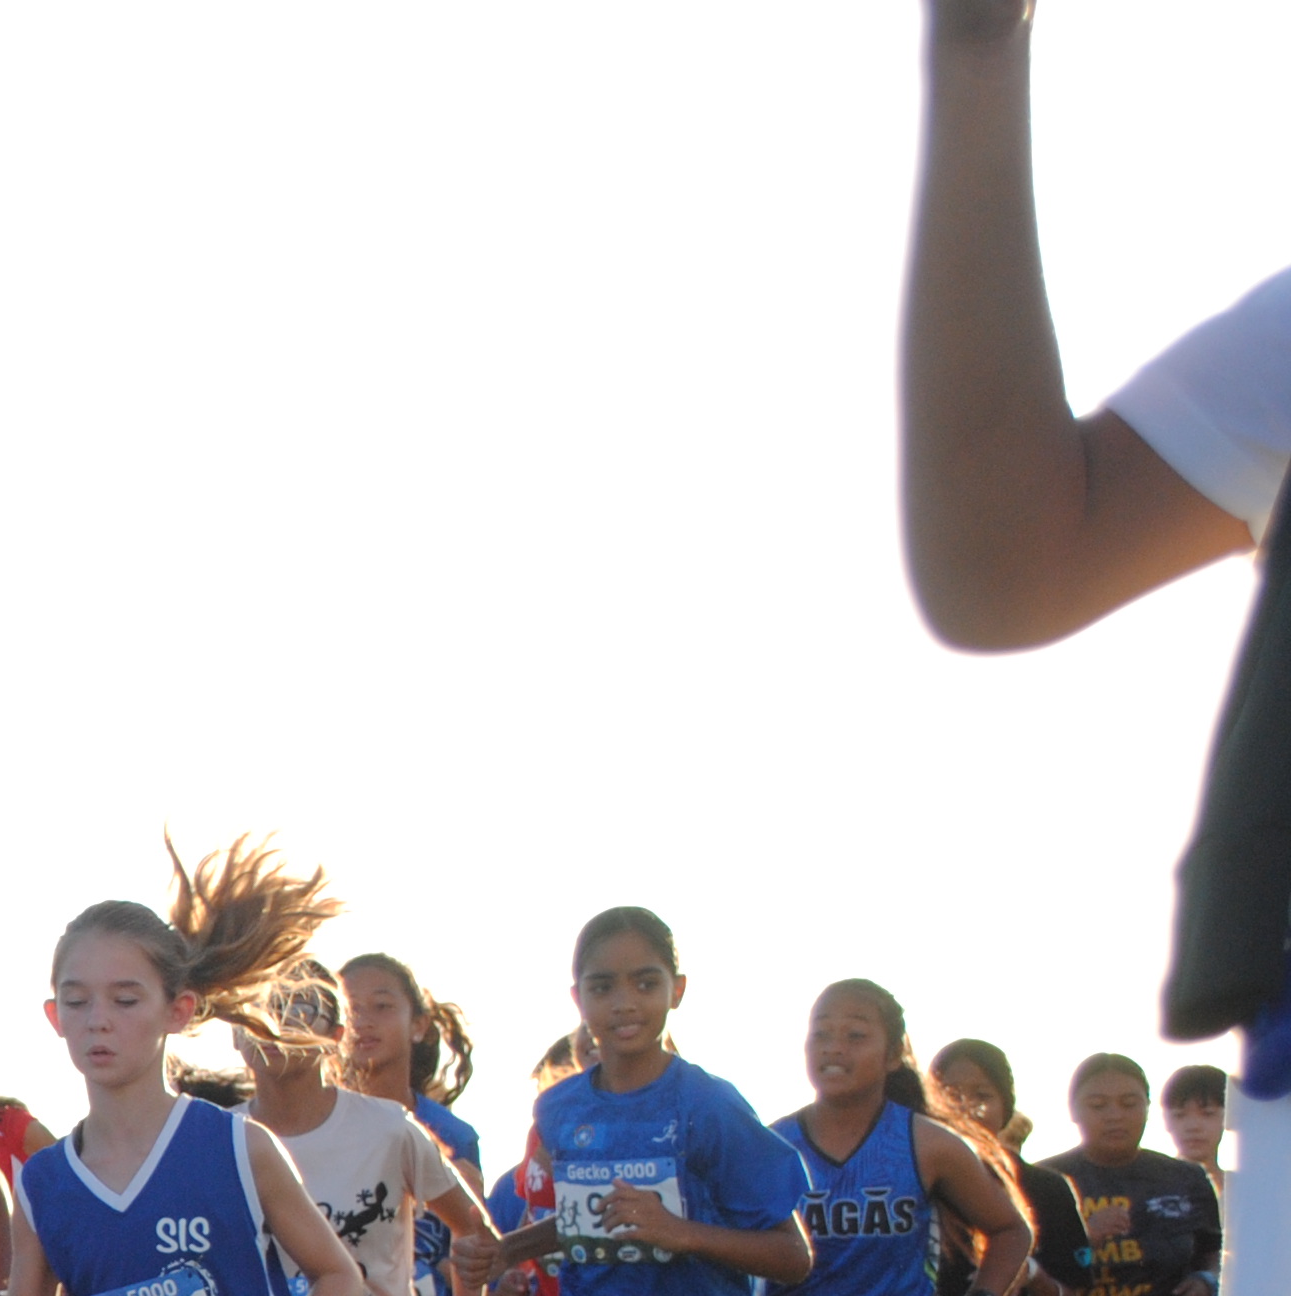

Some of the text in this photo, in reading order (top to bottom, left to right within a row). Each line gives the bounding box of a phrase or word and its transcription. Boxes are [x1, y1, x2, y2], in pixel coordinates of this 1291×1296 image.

[566, 1161, 657, 1181] Gecko 5000
[155, 1216, 211, 1254] SIS
